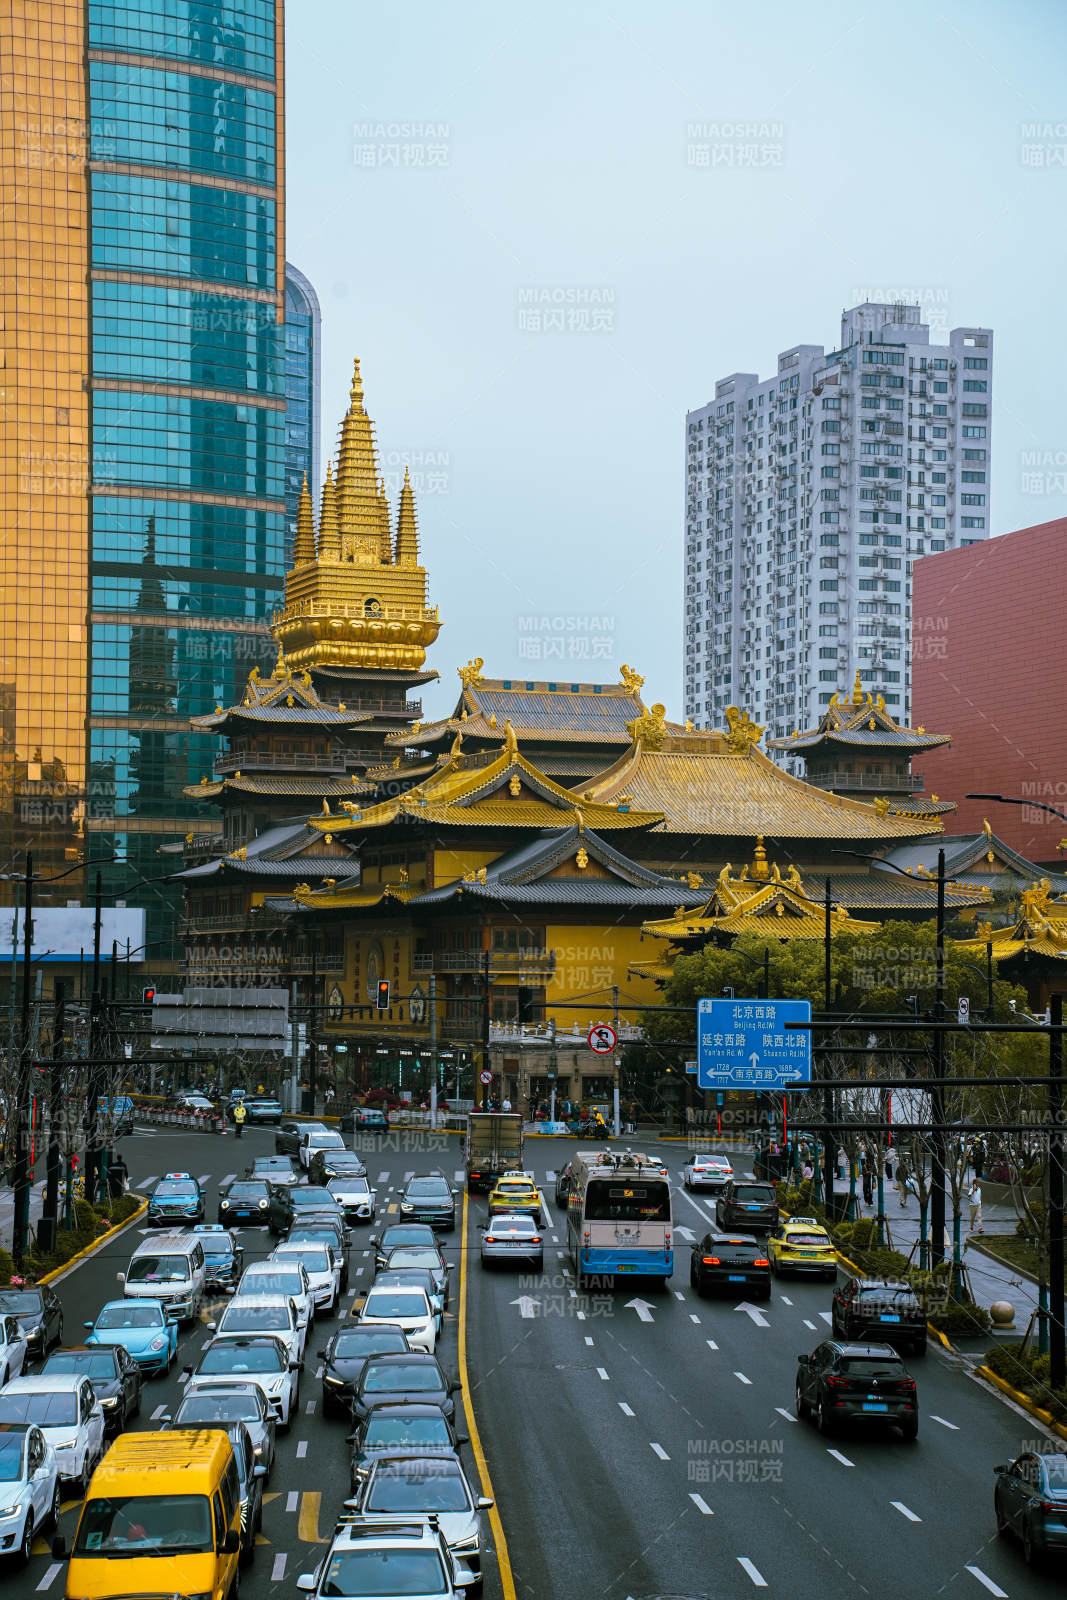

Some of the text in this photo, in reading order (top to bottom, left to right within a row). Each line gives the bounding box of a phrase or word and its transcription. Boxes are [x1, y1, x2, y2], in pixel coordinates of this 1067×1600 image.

[732, 1005, 776, 1019] 北京西路
[734, 1021, 756, 1031] Beijing
[702, 1033, 746, 1047] 延安西路
[762, 1034, 806, 1048] 陕西北路
[735, 1069, 773, 1080] 南京西路
